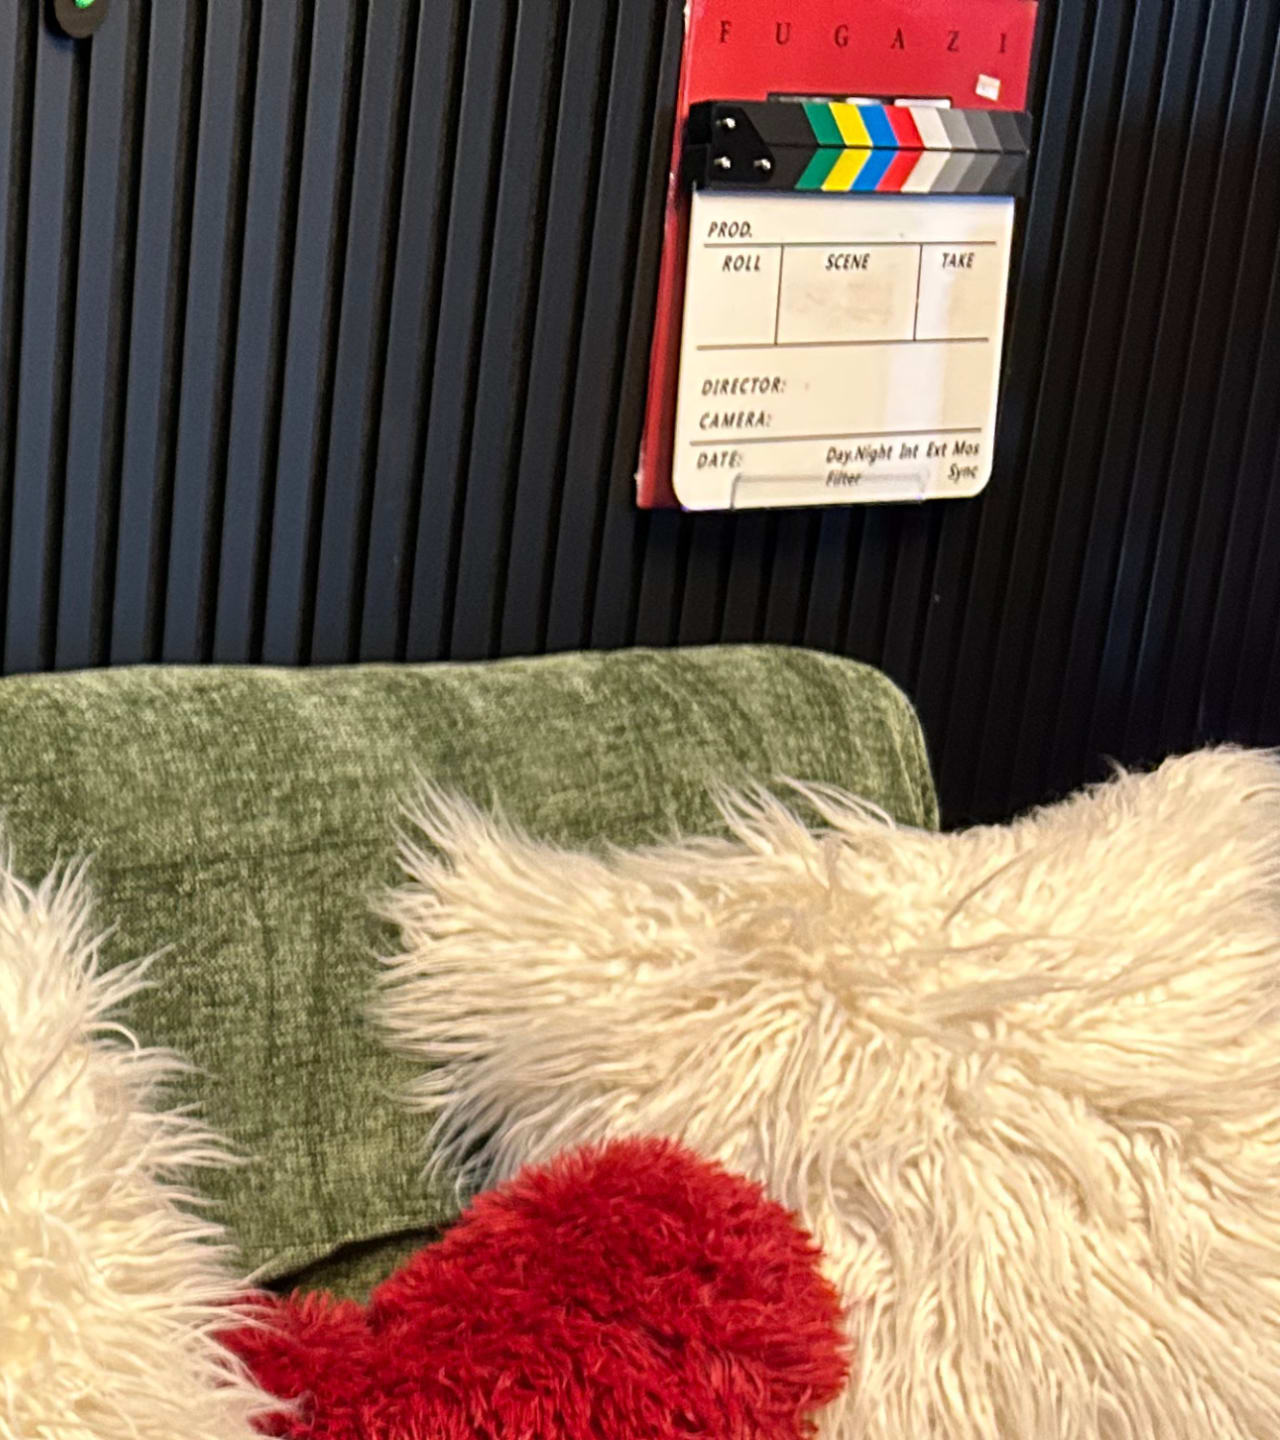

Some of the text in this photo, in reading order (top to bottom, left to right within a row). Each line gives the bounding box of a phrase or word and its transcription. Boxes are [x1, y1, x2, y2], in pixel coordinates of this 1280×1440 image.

[707, 221, 753, 238] PROD.
[722, 254, 761, 272] ROLL
[825, 252, 871, 271] SCENE
[941, 252, 975, 269] TAKE
[701, 376, 786, 396] DIRECTOR:
[699, 410, 773, 430] CAMERA:
[696, 450, 743, 469] DATE:
[899, 441, 919, 460] Int
[926, 441, 948, 458] Ext
[952, 440, 981, 456] Mos
[826, 470, 862, 488] Filter
[948, 463, 980, 482] Sync
